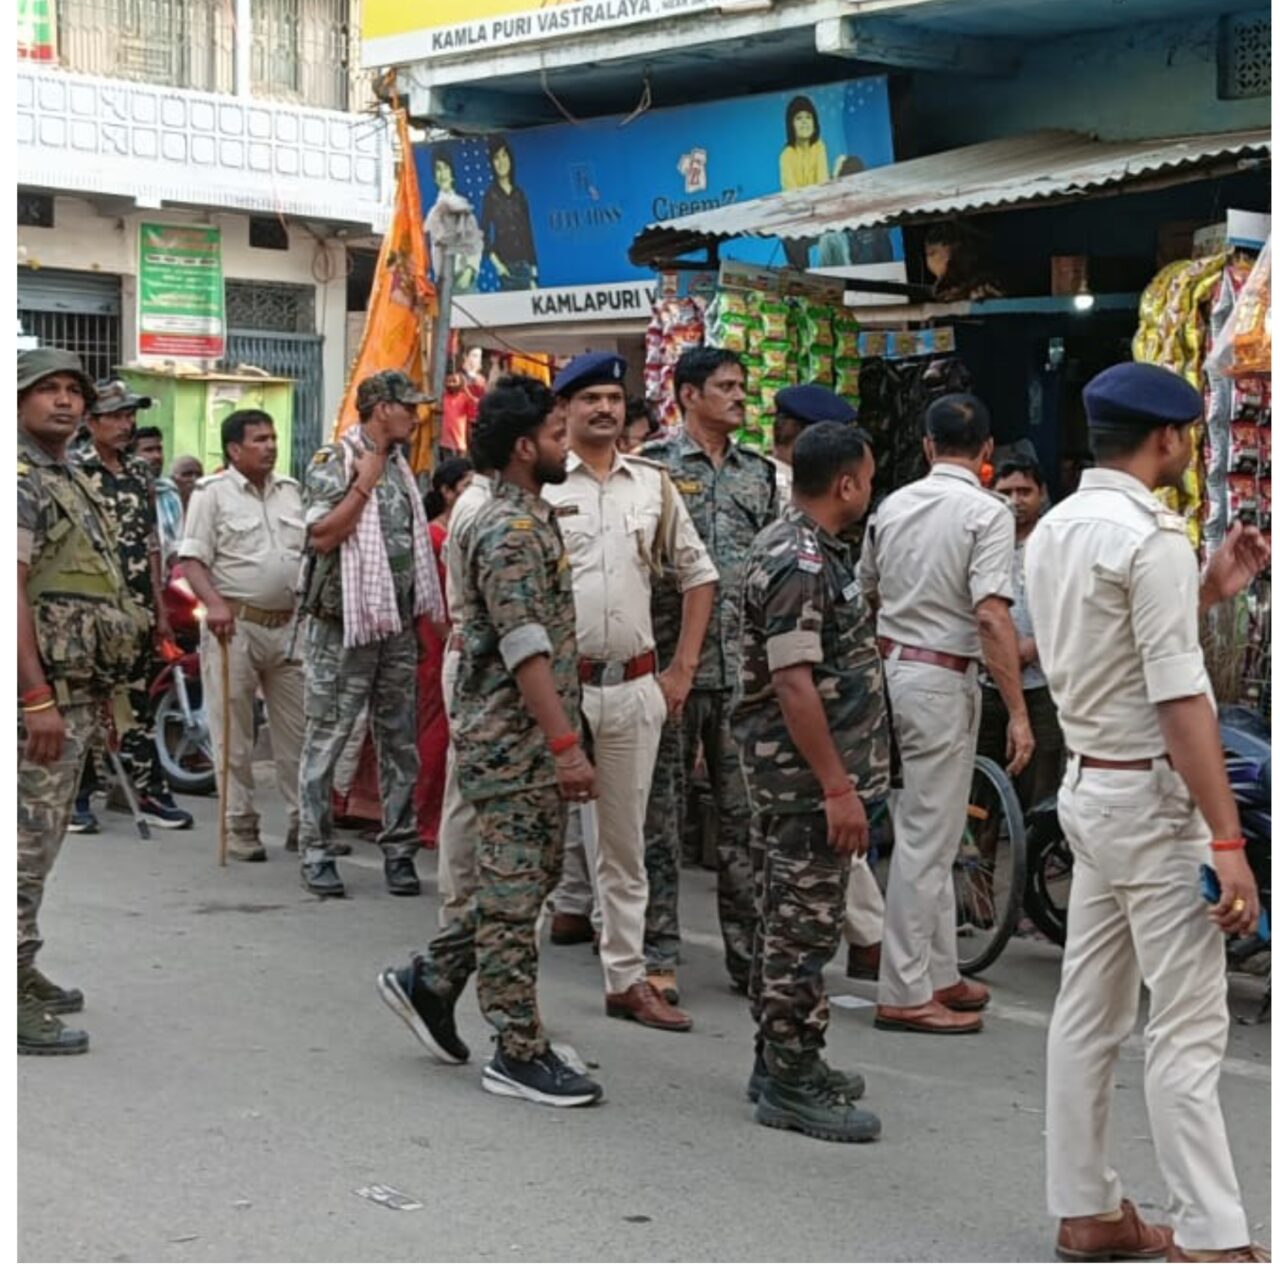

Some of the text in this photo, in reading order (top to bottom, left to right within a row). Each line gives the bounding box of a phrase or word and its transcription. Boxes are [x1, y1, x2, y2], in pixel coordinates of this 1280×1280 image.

[431, 24, 488, 51] KAMLA
[492, 16, 532, 40] PURI
[531, 288, 641, 315] KAMLAPURI
